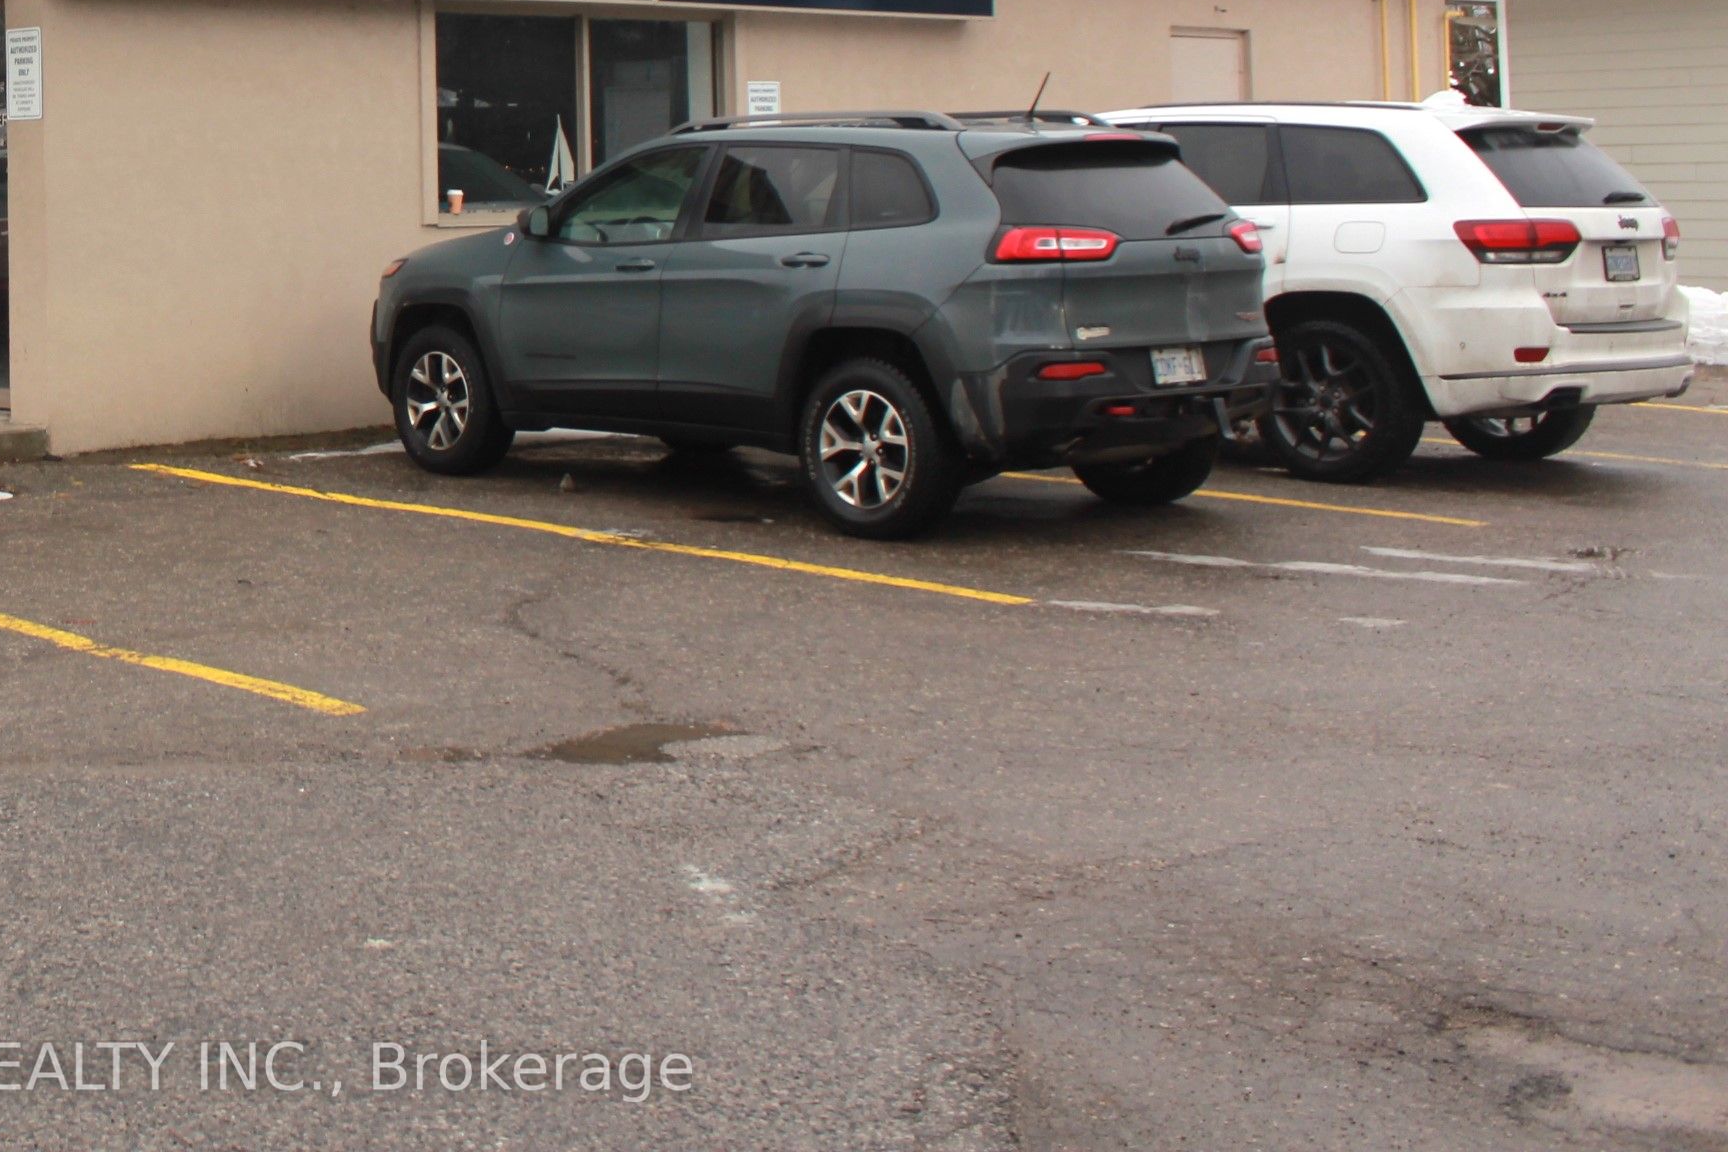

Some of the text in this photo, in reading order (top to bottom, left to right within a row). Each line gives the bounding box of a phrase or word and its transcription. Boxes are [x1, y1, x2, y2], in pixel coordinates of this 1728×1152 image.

[10, 45, 38, 55] AUTHORIZED
[14, 56, 34, 65] PARKING
[18, 68, 30, 77] ONLY
